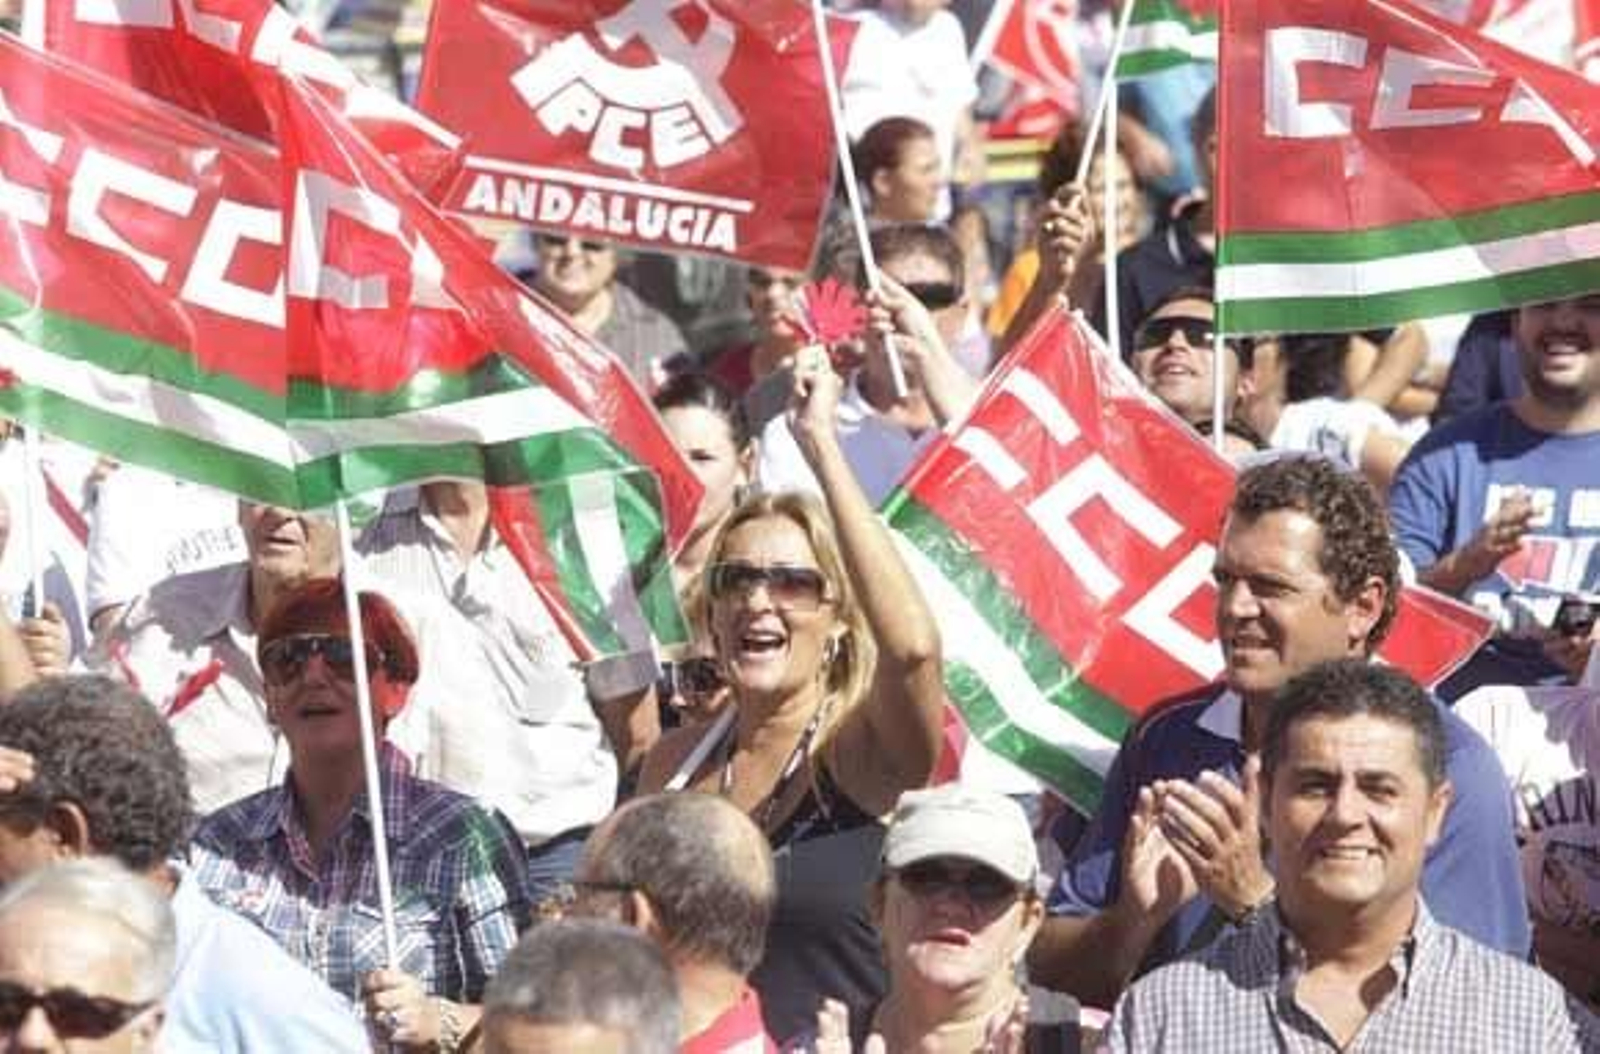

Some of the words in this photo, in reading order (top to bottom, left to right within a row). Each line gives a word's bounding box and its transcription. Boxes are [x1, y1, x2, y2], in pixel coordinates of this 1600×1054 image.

[535, 81, 712, 169] PCE
[462, 172, 738, 252] ANDALUCIA
[1511, 776, 1598, 849] RIN
